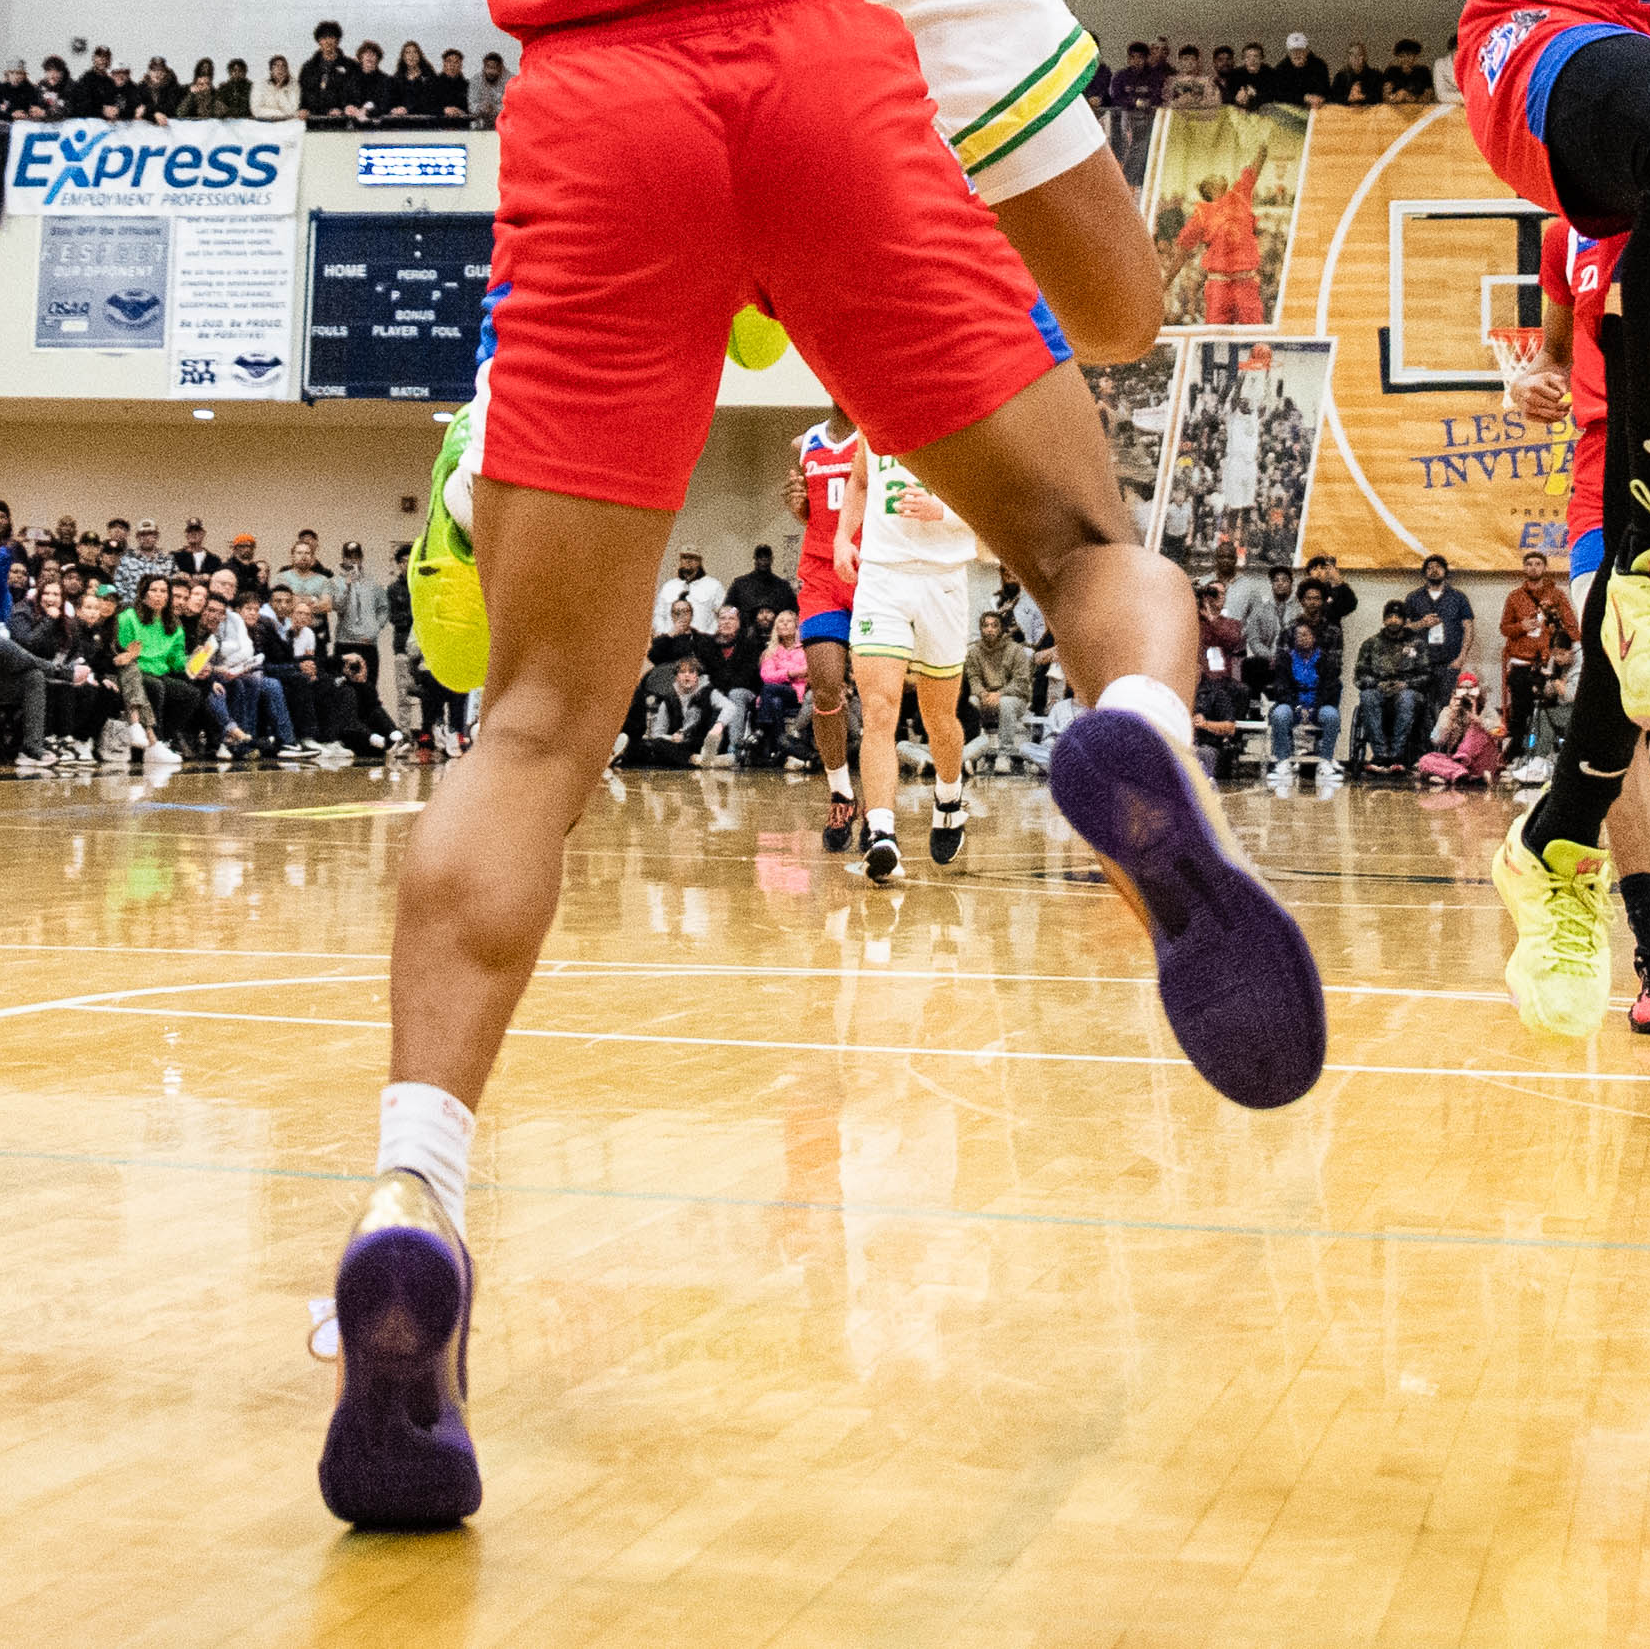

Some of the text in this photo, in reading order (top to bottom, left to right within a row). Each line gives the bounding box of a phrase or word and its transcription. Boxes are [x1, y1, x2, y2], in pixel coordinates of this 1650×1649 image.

[324, 264, 492, 278] HOME GUE
[311, 325, 461, 338] FOULS PLAYER FOUL
[1440, 411, 1526, 447] LES
